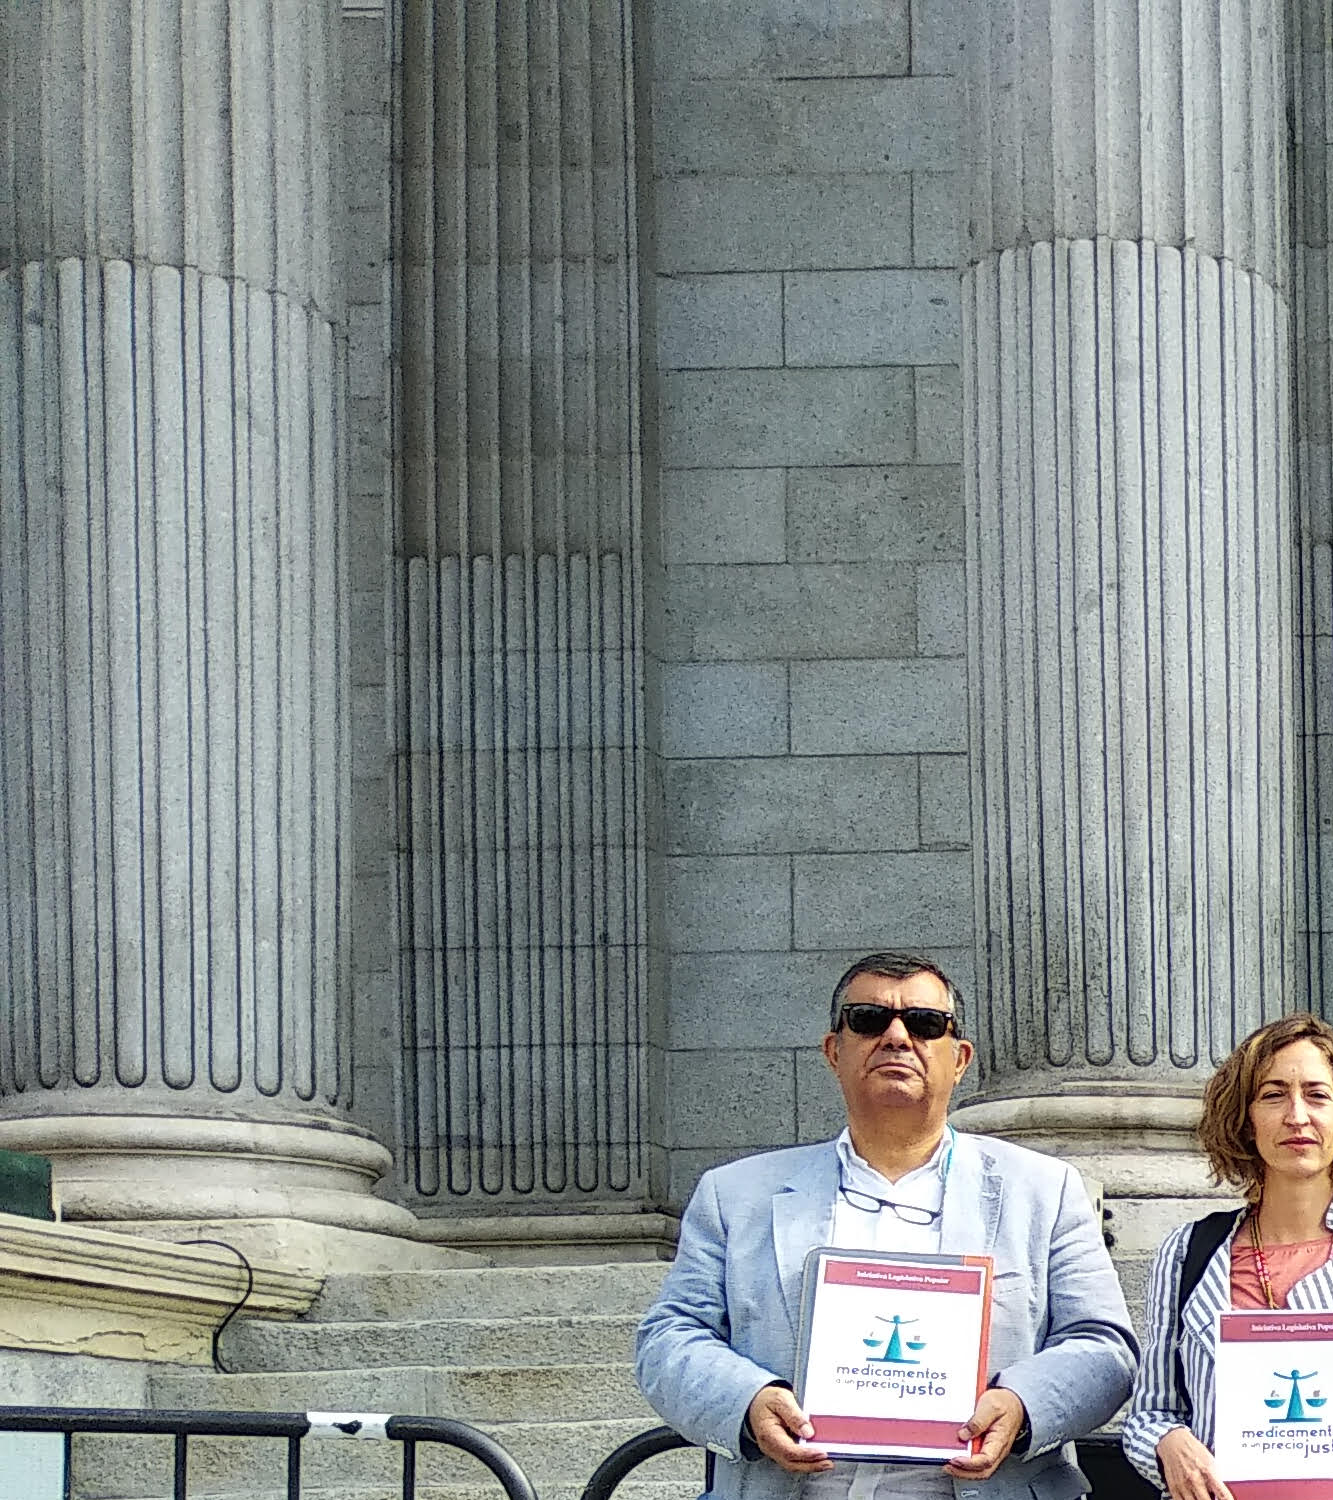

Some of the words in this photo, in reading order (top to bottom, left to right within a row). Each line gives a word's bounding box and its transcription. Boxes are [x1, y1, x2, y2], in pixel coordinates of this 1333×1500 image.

[836, 1364, 947, 1380] medicamentos
[856, 1378, 900, 1390] precio
[899, 1379, 946, 1398] justo
[1262, 1439, 1304, 1453] precio
